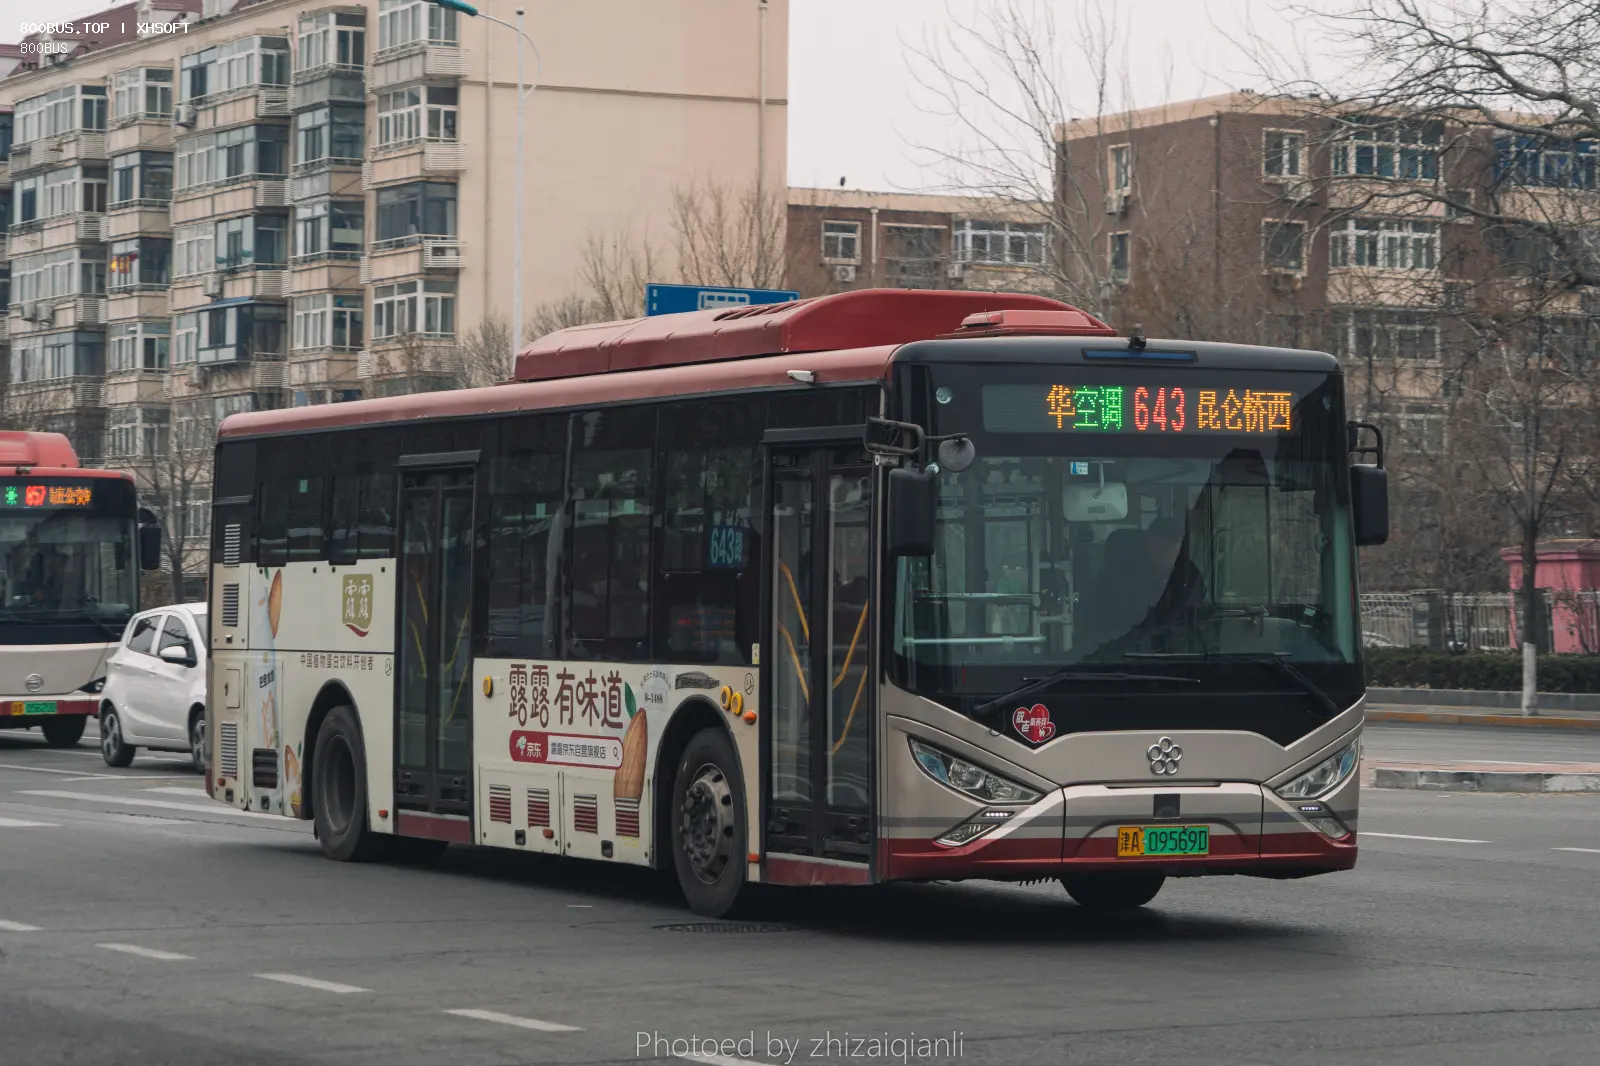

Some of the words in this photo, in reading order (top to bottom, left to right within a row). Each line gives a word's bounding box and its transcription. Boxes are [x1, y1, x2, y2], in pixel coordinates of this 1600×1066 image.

[1133, 386, 1186, 432] 643
[1198, 389, 1292, 433] 昆仑桥西
[508, 663, 624, 730] 露露有味道
[526, 741, 542, 758] 京东
[550, 741, 607, 760] 露露京东自营旗舰店
